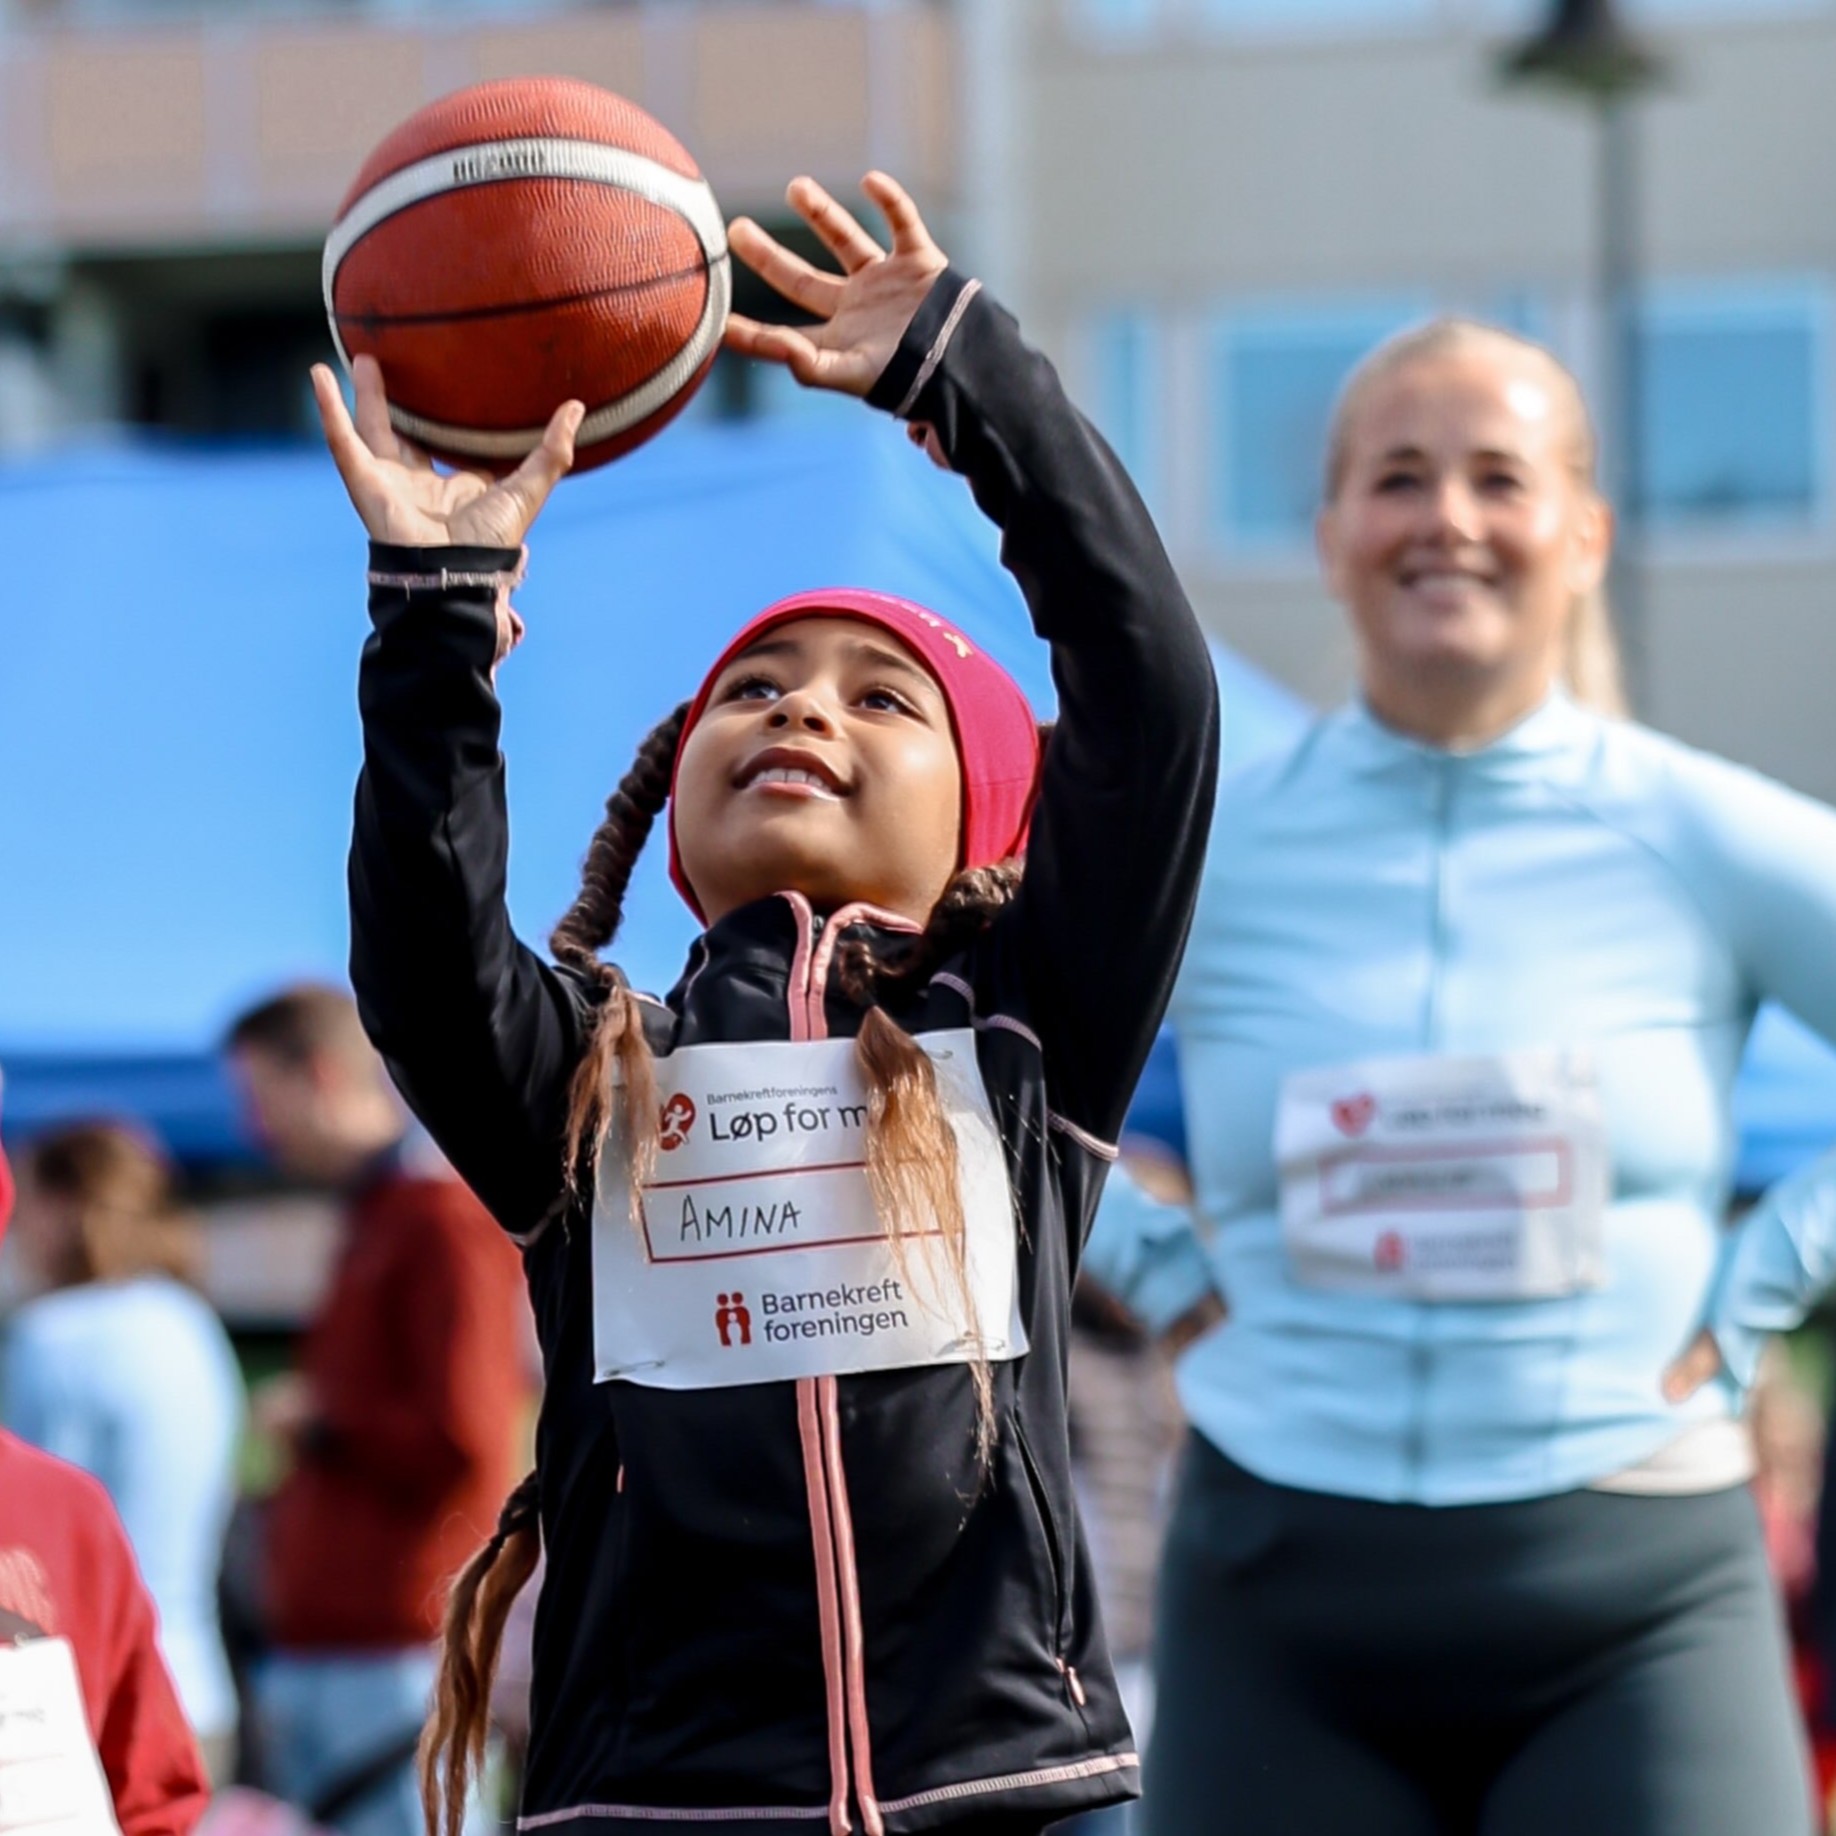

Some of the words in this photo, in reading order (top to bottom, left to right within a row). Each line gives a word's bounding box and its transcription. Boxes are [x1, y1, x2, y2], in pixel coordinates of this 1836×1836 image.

[706, 1085, 838, 1105] Barnekreftforeningens
[709, 1111, 778, 1142] Løp
[782, 1102, 831, 1132] for
[680, 1195, 801, 1241] AMINA
[761, 1279, 903, 1315] Barnekreft
[763, 1308, 909, 1343] foreningen
